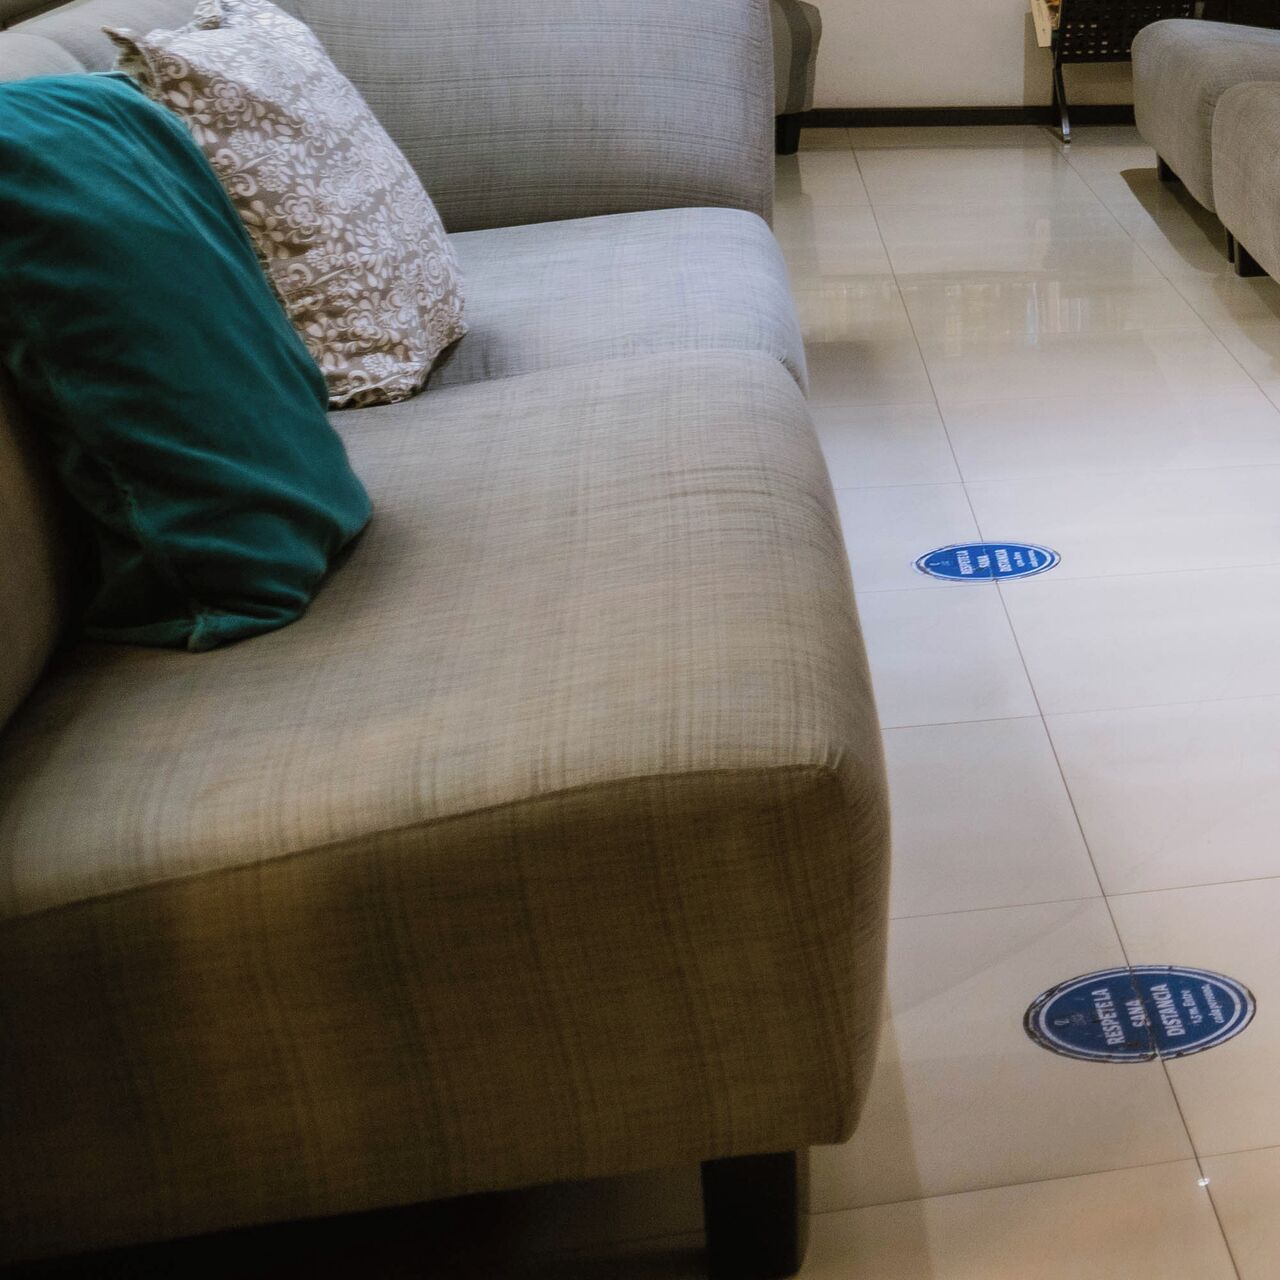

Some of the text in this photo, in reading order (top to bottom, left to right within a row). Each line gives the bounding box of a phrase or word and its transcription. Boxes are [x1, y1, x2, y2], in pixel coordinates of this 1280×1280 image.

[1091, 988, 1125, 1045] RESPETE LA
[1126, 999, 1148, 1027] SANA
[1150, 983, 1187, 1037] DISTANCIA
